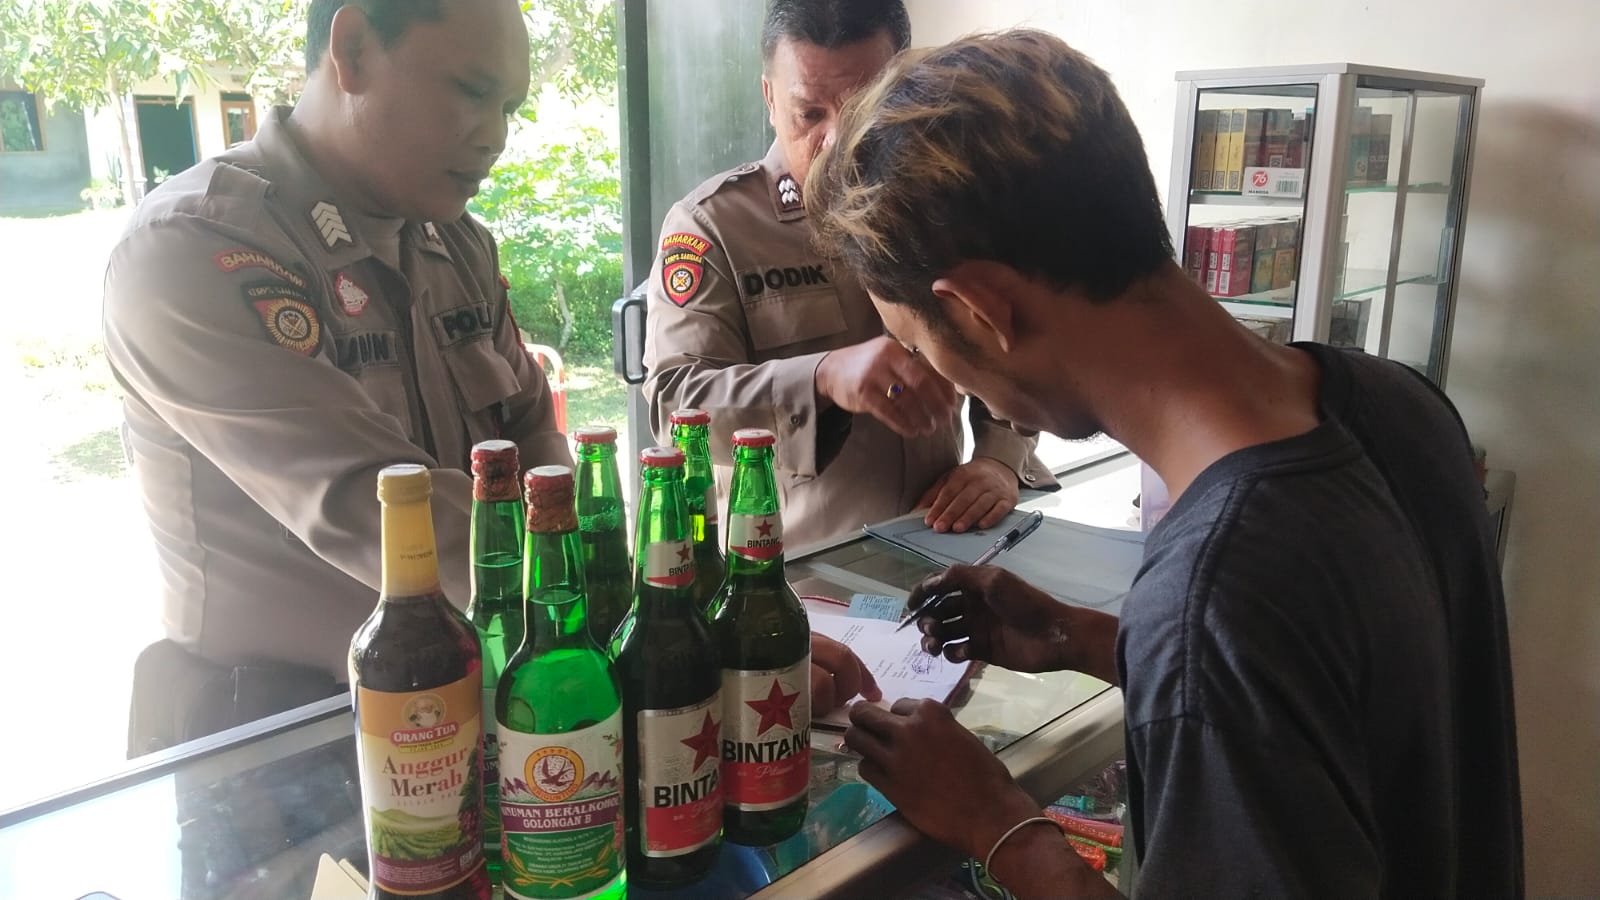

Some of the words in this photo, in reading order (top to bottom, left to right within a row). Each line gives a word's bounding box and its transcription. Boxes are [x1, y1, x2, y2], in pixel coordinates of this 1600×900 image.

[664, 234, 706, 252] BAHARKAM
[743, 265, 829, 295] DODIK
[393, 730, 433, 742] ORANG
[434, 724, 457, 736] TUA
[382, 747, 468, 779] Anggur
[391, 769, 464, 797] Merah
[523, 816, 582, 829] GOLONGAN
[584, 814, 592, 824] B
